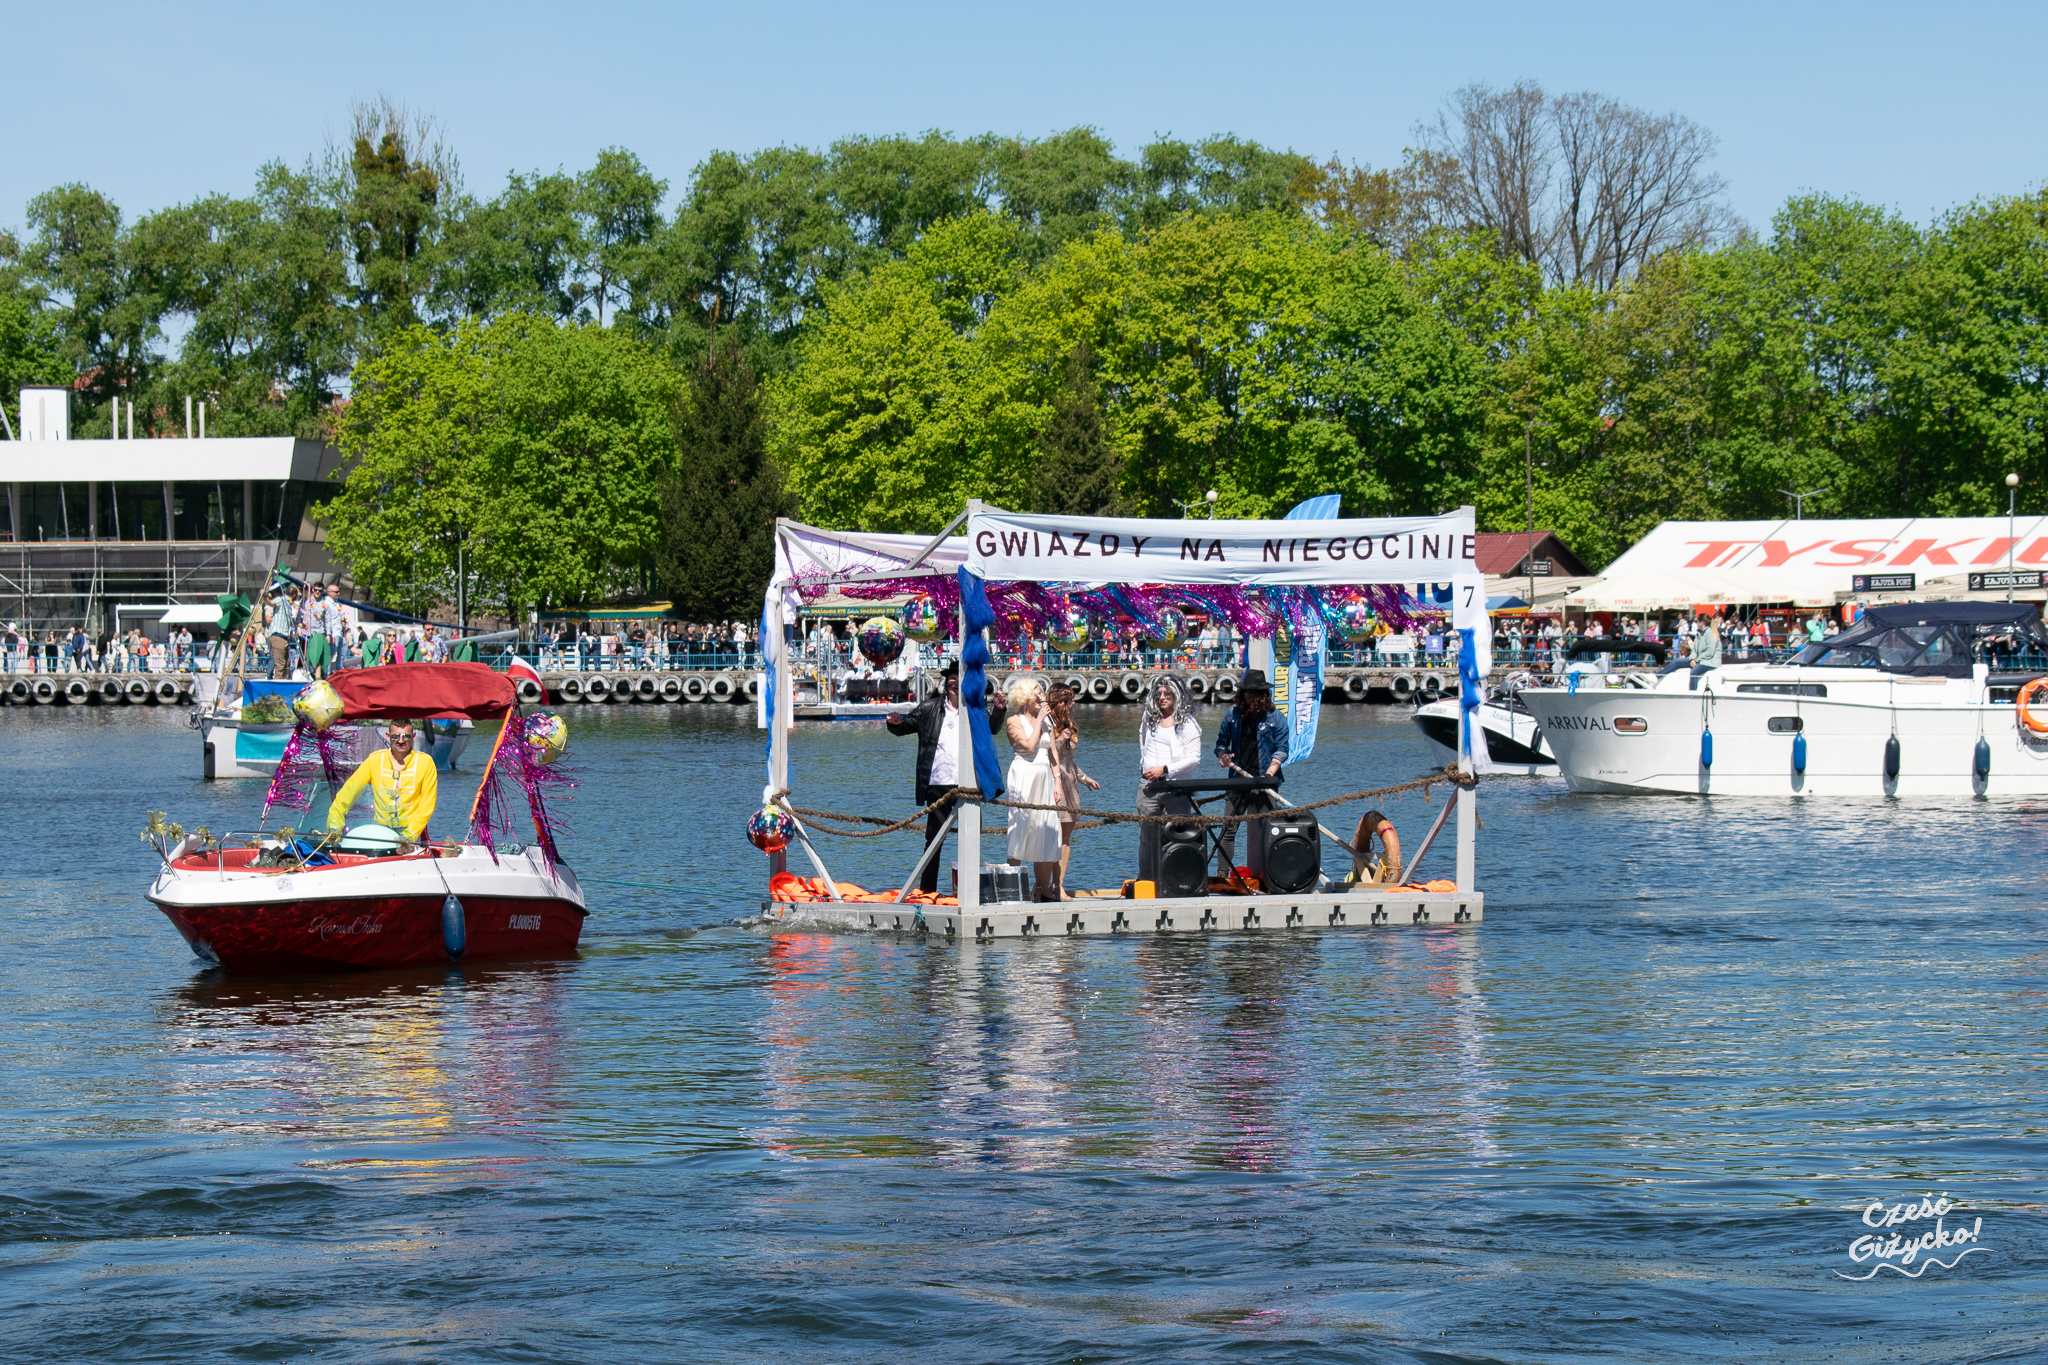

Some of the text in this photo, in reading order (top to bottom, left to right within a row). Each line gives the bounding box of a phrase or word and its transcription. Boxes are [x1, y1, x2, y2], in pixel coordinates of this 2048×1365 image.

[975, 530, 1476, 563] GWIAZDY NA NIEGOCINIE
[1870, 578, 1895, 587] KAJUTA
[1896, 577, 1912, 586] PORT
[2018, 575, 2040, 585] PORT
[1463, 585, 1475, 609] 7
[1273, 664, 1290, 702] KLUB
[1547, 716, 1611, 731] ARRIVAL
